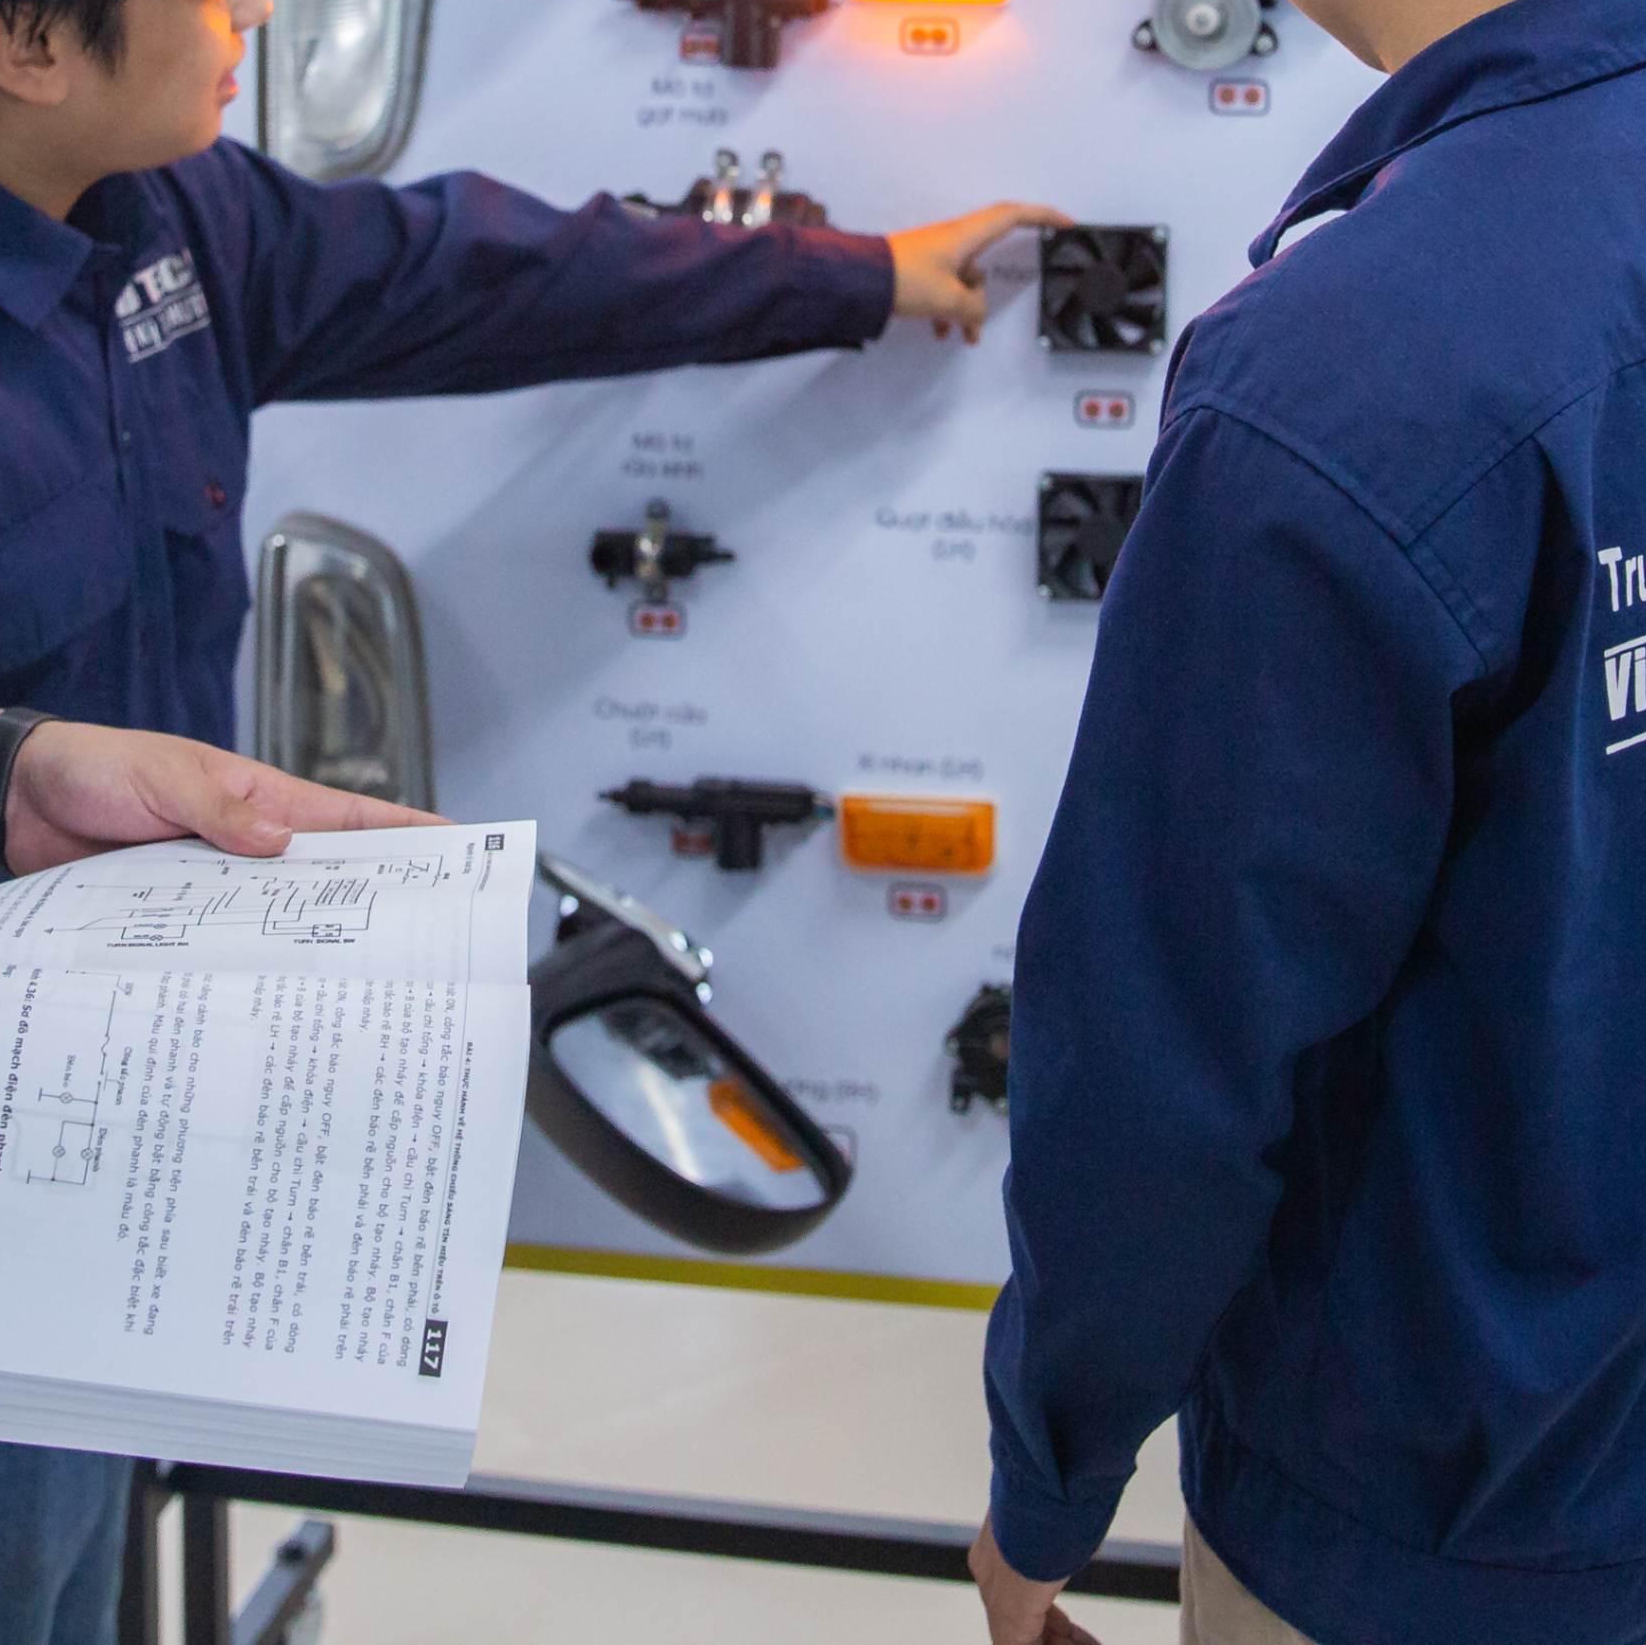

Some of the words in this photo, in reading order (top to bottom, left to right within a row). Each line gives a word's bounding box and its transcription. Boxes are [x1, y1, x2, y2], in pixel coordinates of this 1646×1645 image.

[23, 980, 38, 1002] 4.36:
[20, 1003, 32, 1018] Sơ
[16, 1019, 29, 1034] đồ
[9, 1036, 24, 1070] mạch
[3, 1072, 18, 1101] điện
[424, 1328, 442, 1368] 117
